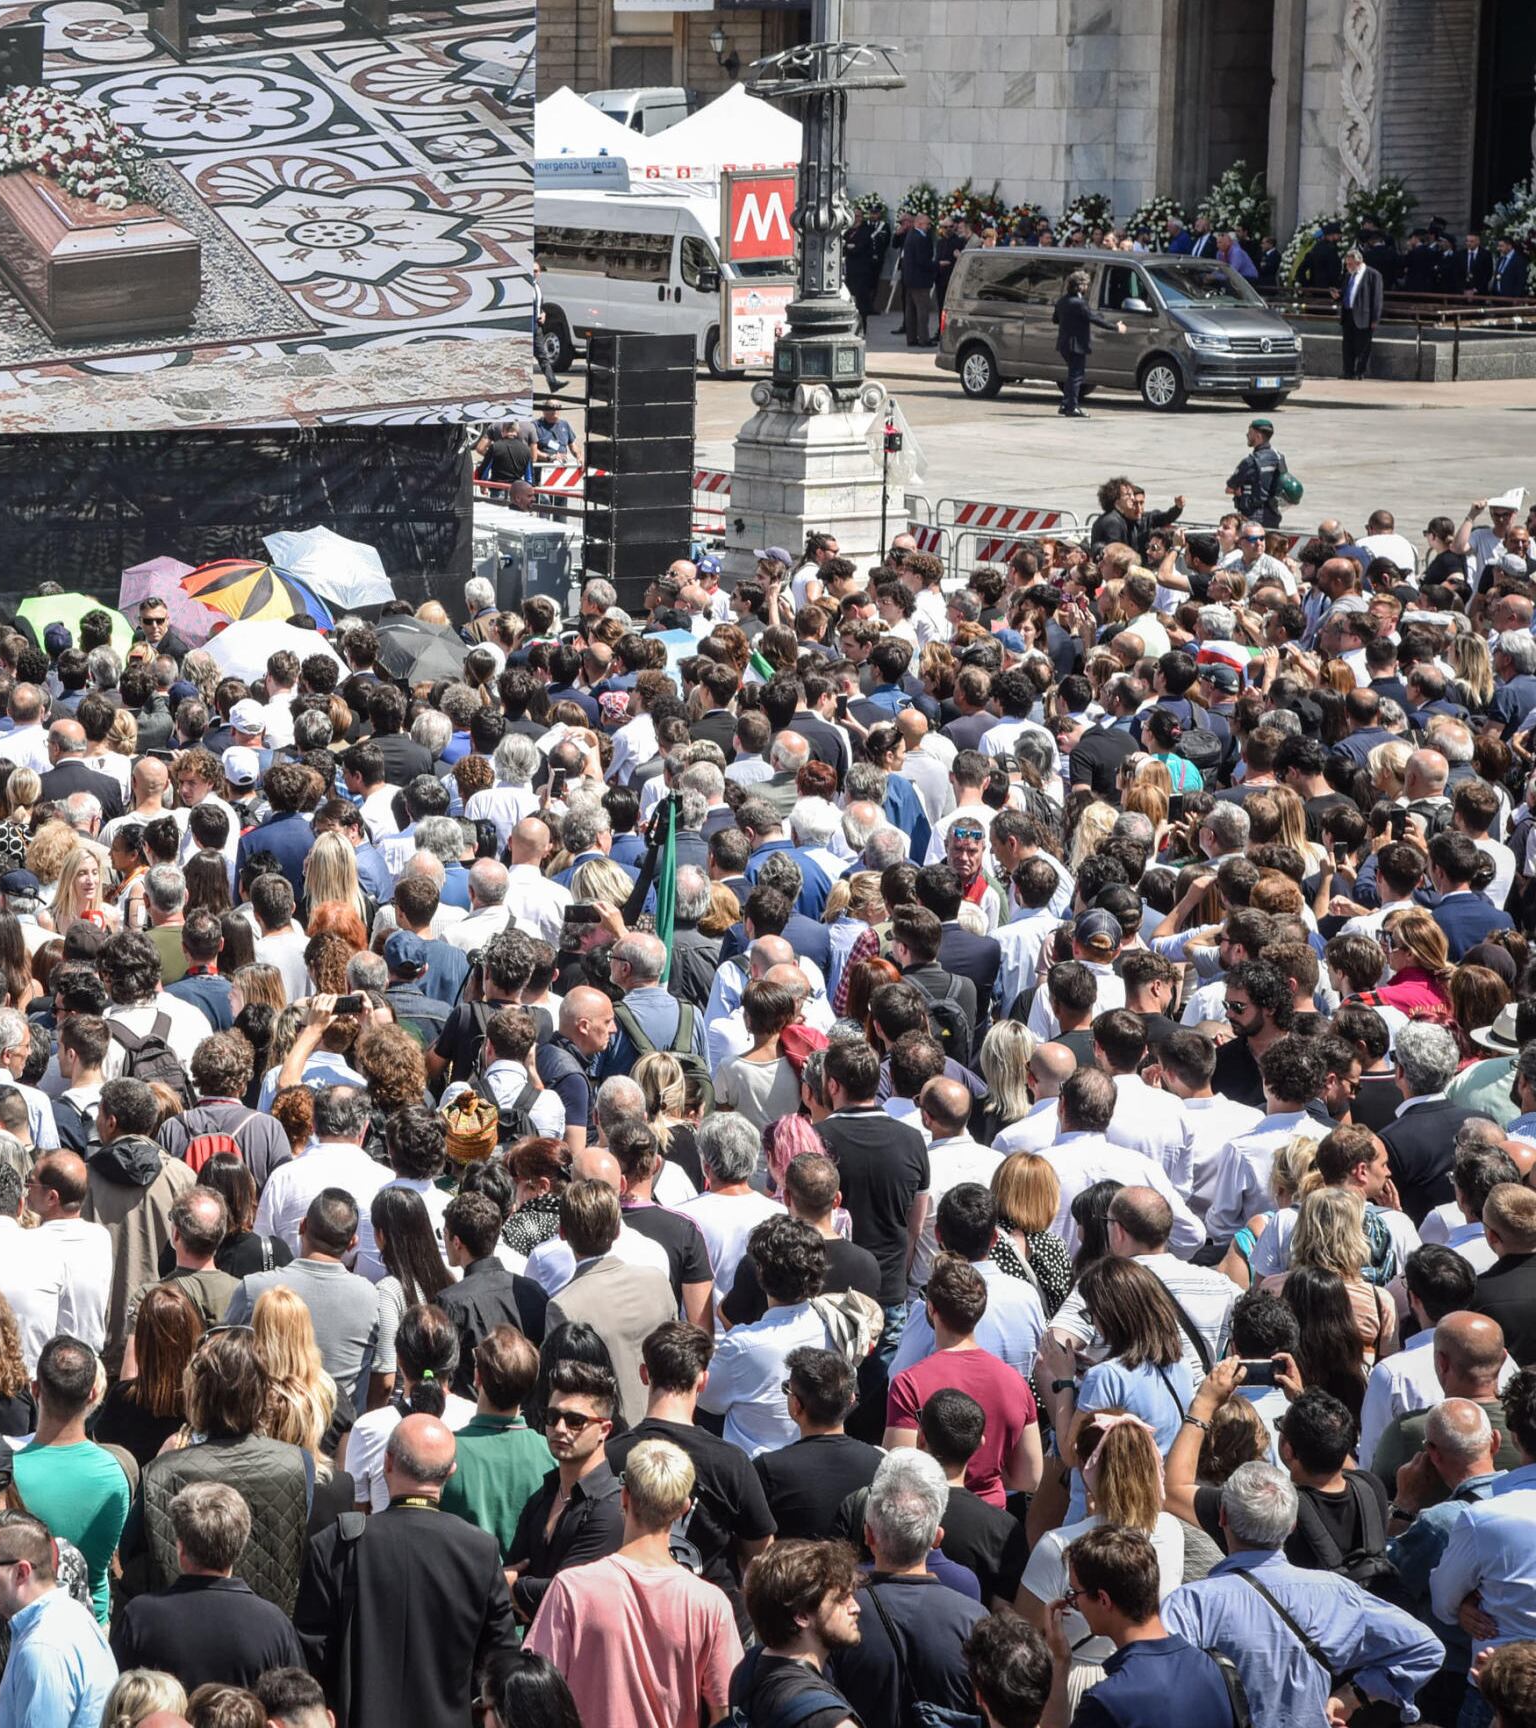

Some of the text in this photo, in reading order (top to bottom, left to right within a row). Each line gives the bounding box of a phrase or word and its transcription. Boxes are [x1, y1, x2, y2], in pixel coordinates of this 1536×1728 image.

[534, 162, 578, 171] mergenza
[580, 161, 617, 172] Urgenza
[734, 192, 791, 242] M
